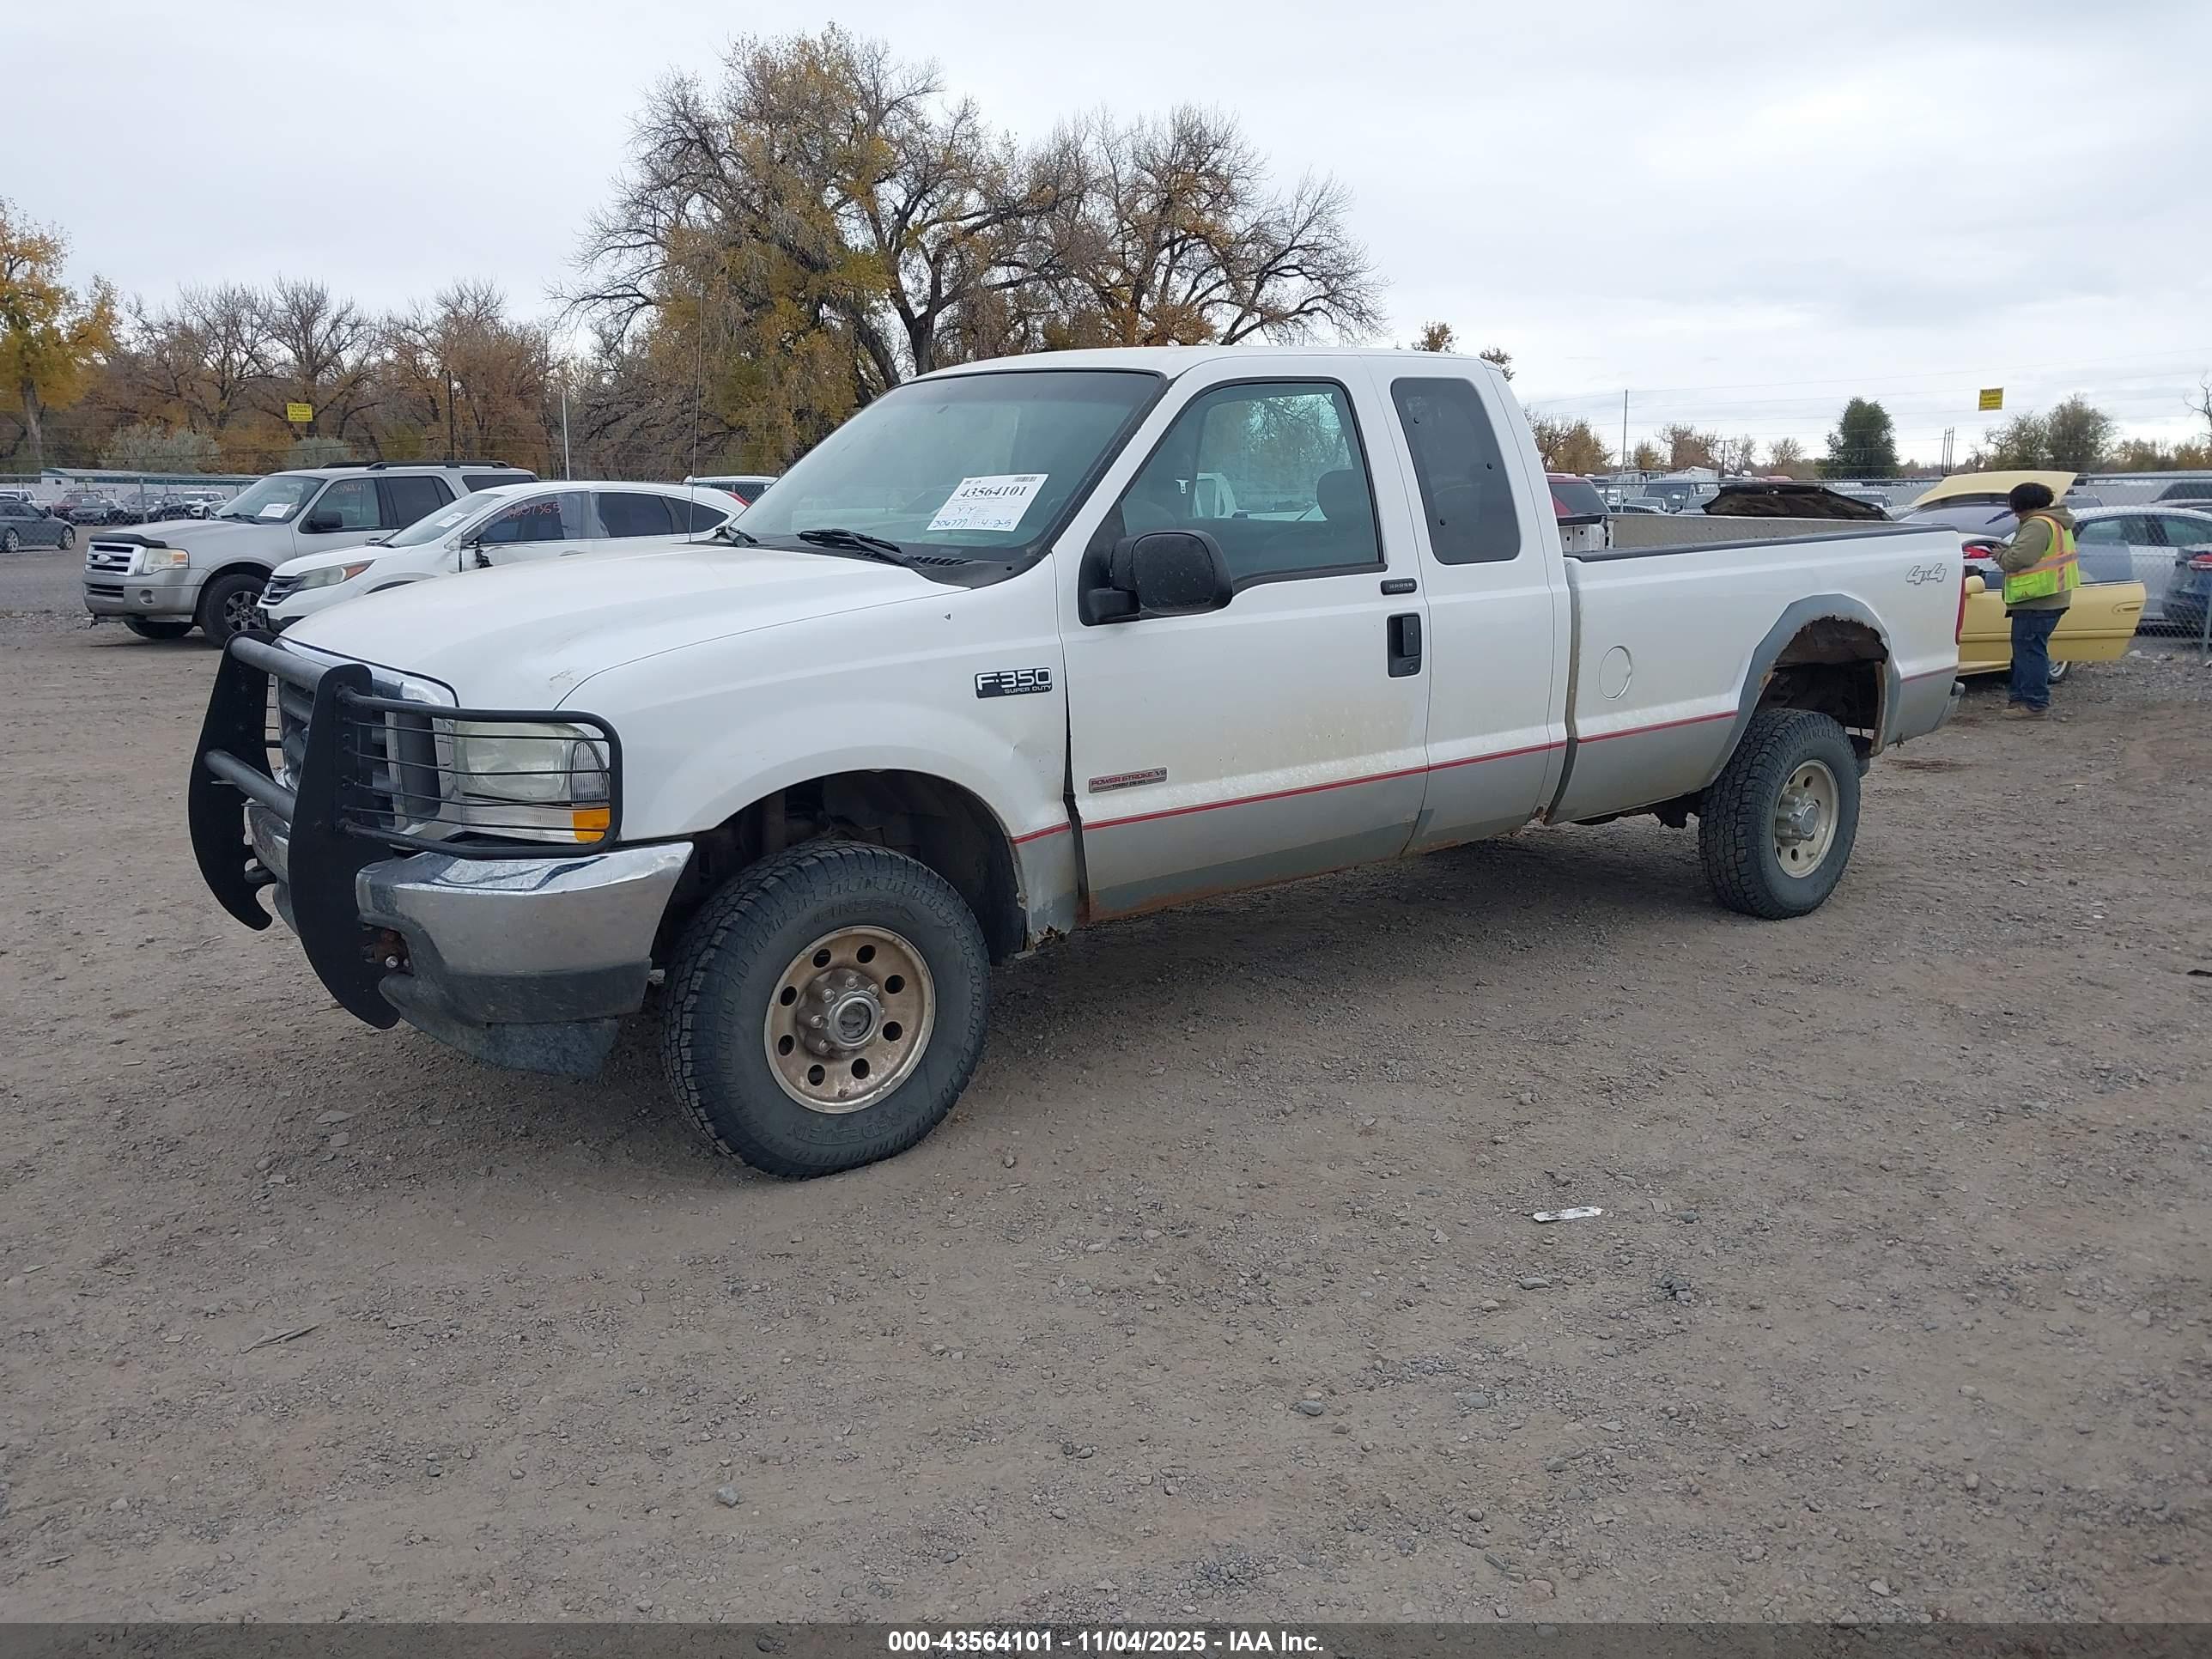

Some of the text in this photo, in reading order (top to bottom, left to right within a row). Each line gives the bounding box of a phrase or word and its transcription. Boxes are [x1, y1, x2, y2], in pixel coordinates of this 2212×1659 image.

[959, 485, 1028, 498] 43564101
[1905, 562, 1948, 585] 4x4
[1091, 776, 1121, 786] POWER
[1121, 771, 1154, 781] STROKE
